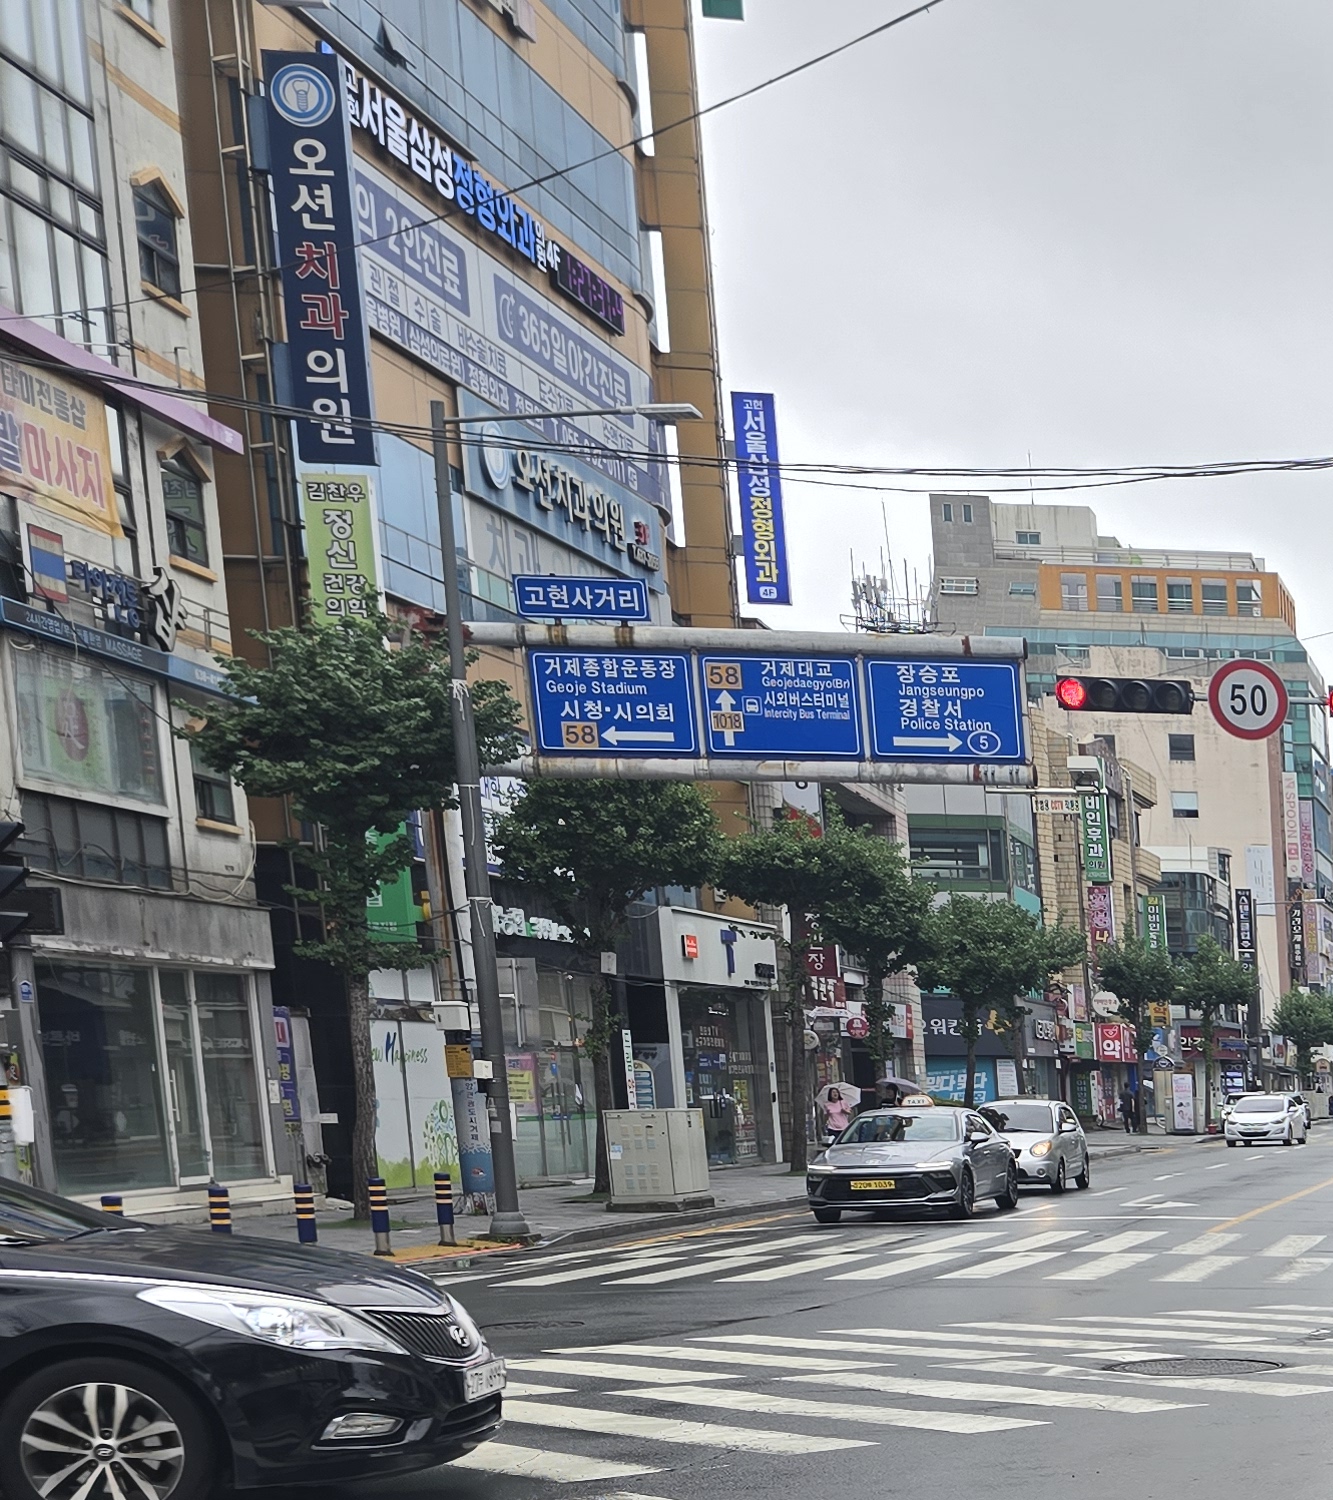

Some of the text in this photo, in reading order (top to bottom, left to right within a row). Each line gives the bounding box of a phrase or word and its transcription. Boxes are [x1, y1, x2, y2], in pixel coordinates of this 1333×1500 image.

[361, 77, 536, 264] 서울삼성정형외과
[386, 207, 462, 300] 2인진료
[289, 138, 356, 445] 오션치과의원
[518, 305, 628, 411] 365일야간진료
[23, 422, 106, 510] 마사지
[306, 482, 366, 502] 김찬우
[514, 450, 627, 553] 오션치과의원
[324, 508, 357, 569] 정신
[524, 584, 640, 611] 고현사거리
[104, 637, 143, 662] MASSAGE
[544, 656, 676, 679] 거제종합운동장
[709, 665, 740, 685] 58
[761, 661, 833, 678] 거제대교
[897, 664, 961, 684] 장승포
[546, 680, 647, 695] Geoje Stadium
[762, 677, 850, 691] Geojedaegyo(Br)
[898, 684, 985, 699] Jangseungpo
[764, 691, 850, 709] 시외버스터미널
[900, 698, 963, 719] 경찰서
[1230, 684, 1268, 717] 50
[560, 699, 675, 723] 시청·시의회
[713, 713, 742, 730] 1018
[764, 707, 850, 720] Intercity Bus Terminal
[565, 726, 596, 744] 58
[901, 718, 992, 732] Police Station
[979, 736, 989, 749] 5
[1102, 1039, 1121, 1060] 약
